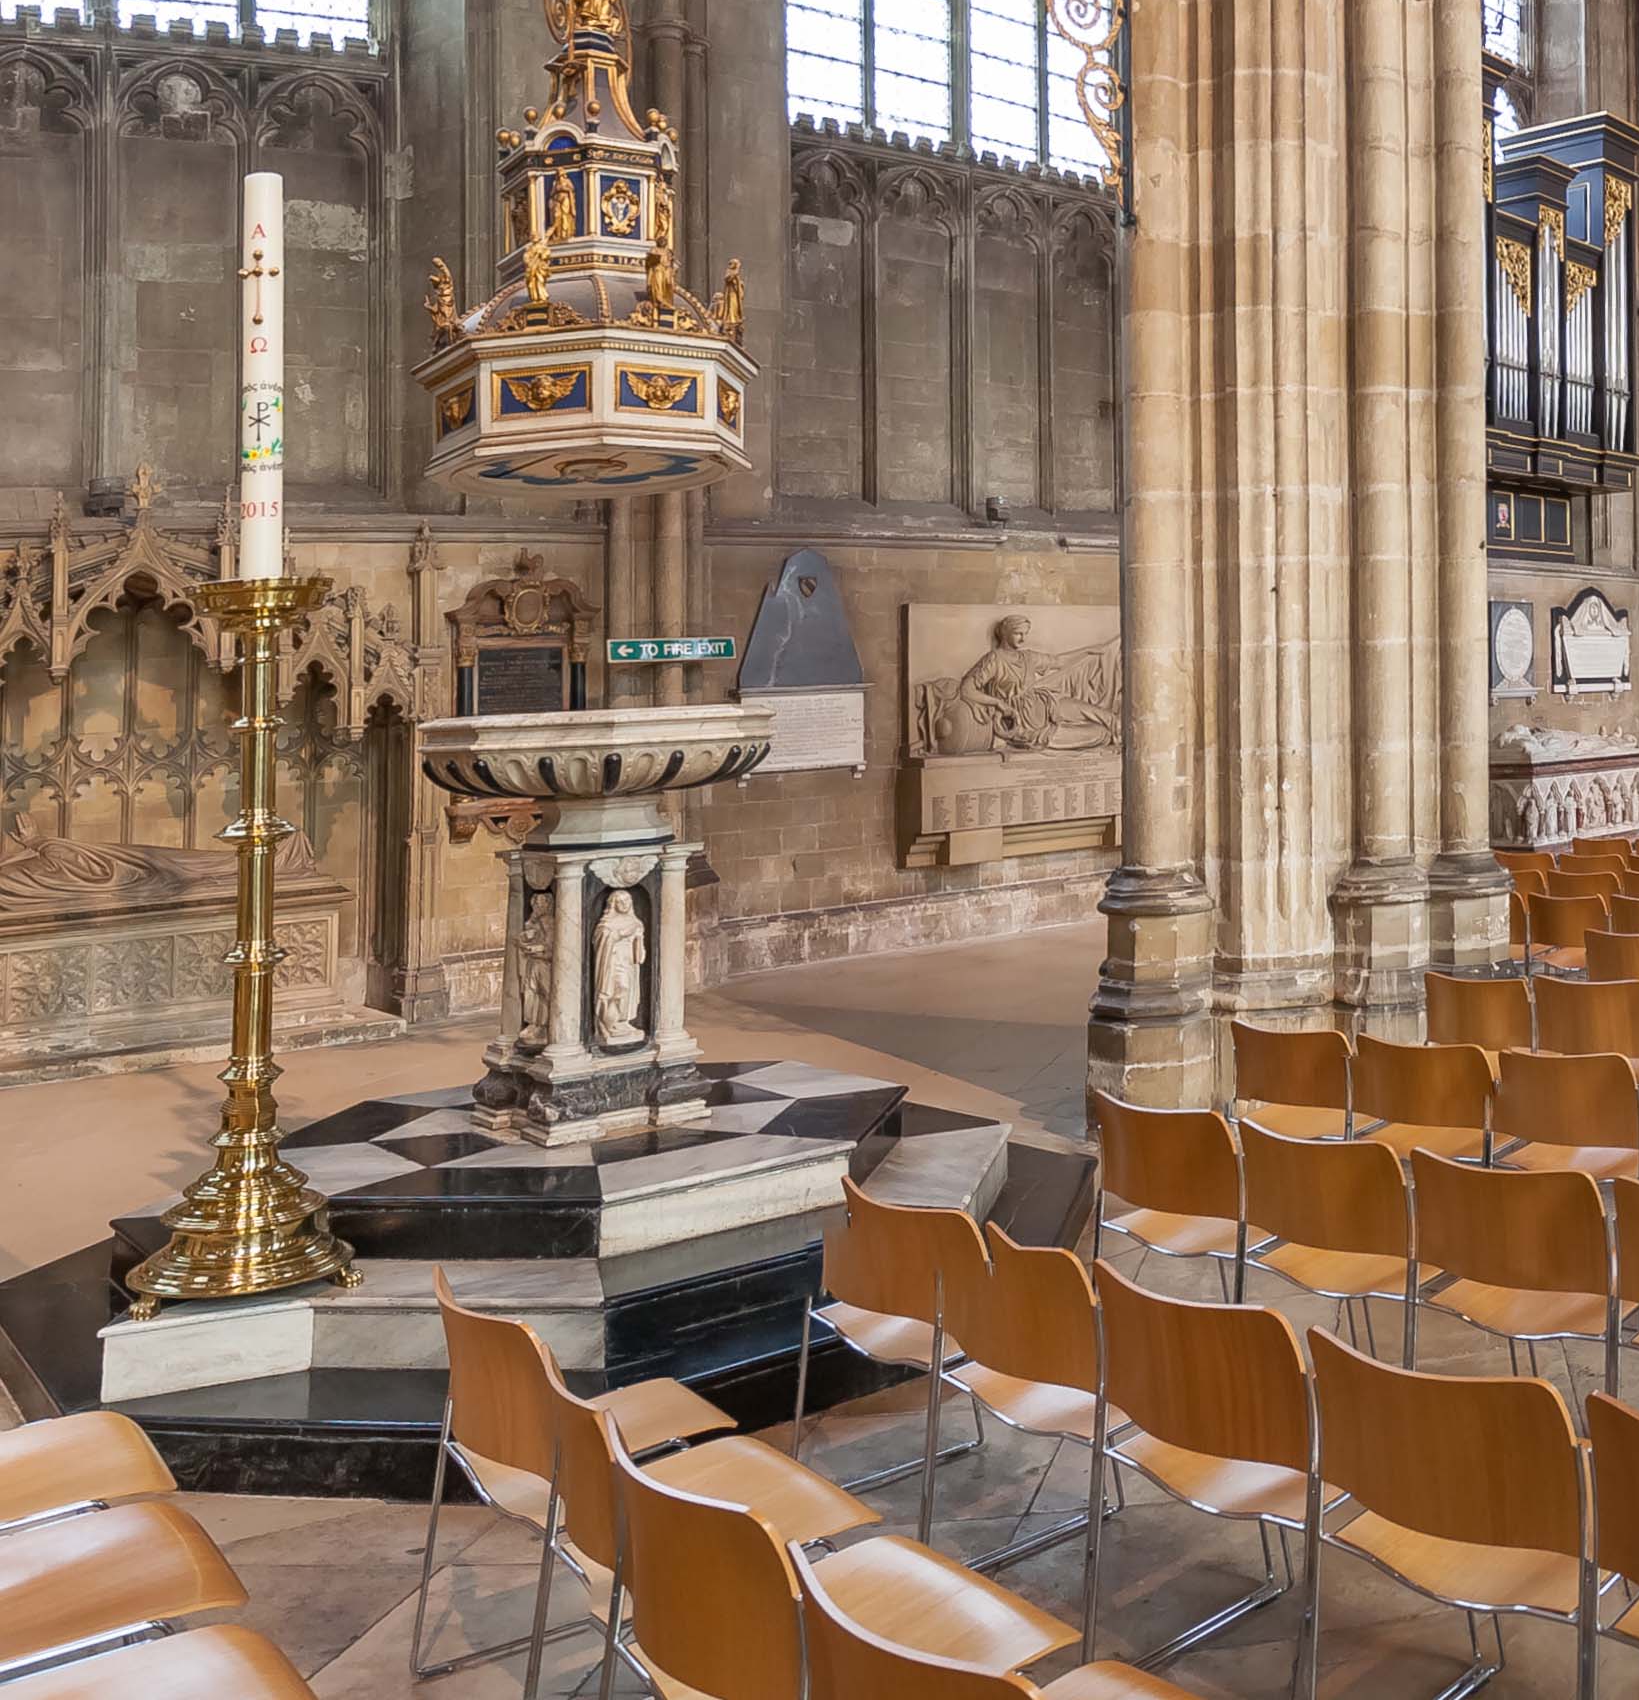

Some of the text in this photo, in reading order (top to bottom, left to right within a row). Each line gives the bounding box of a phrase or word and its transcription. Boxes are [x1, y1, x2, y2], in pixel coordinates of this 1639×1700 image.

[241, 501, 279, 519] 2015
[639, 642, 727, 657] TO FIRE EXIT
